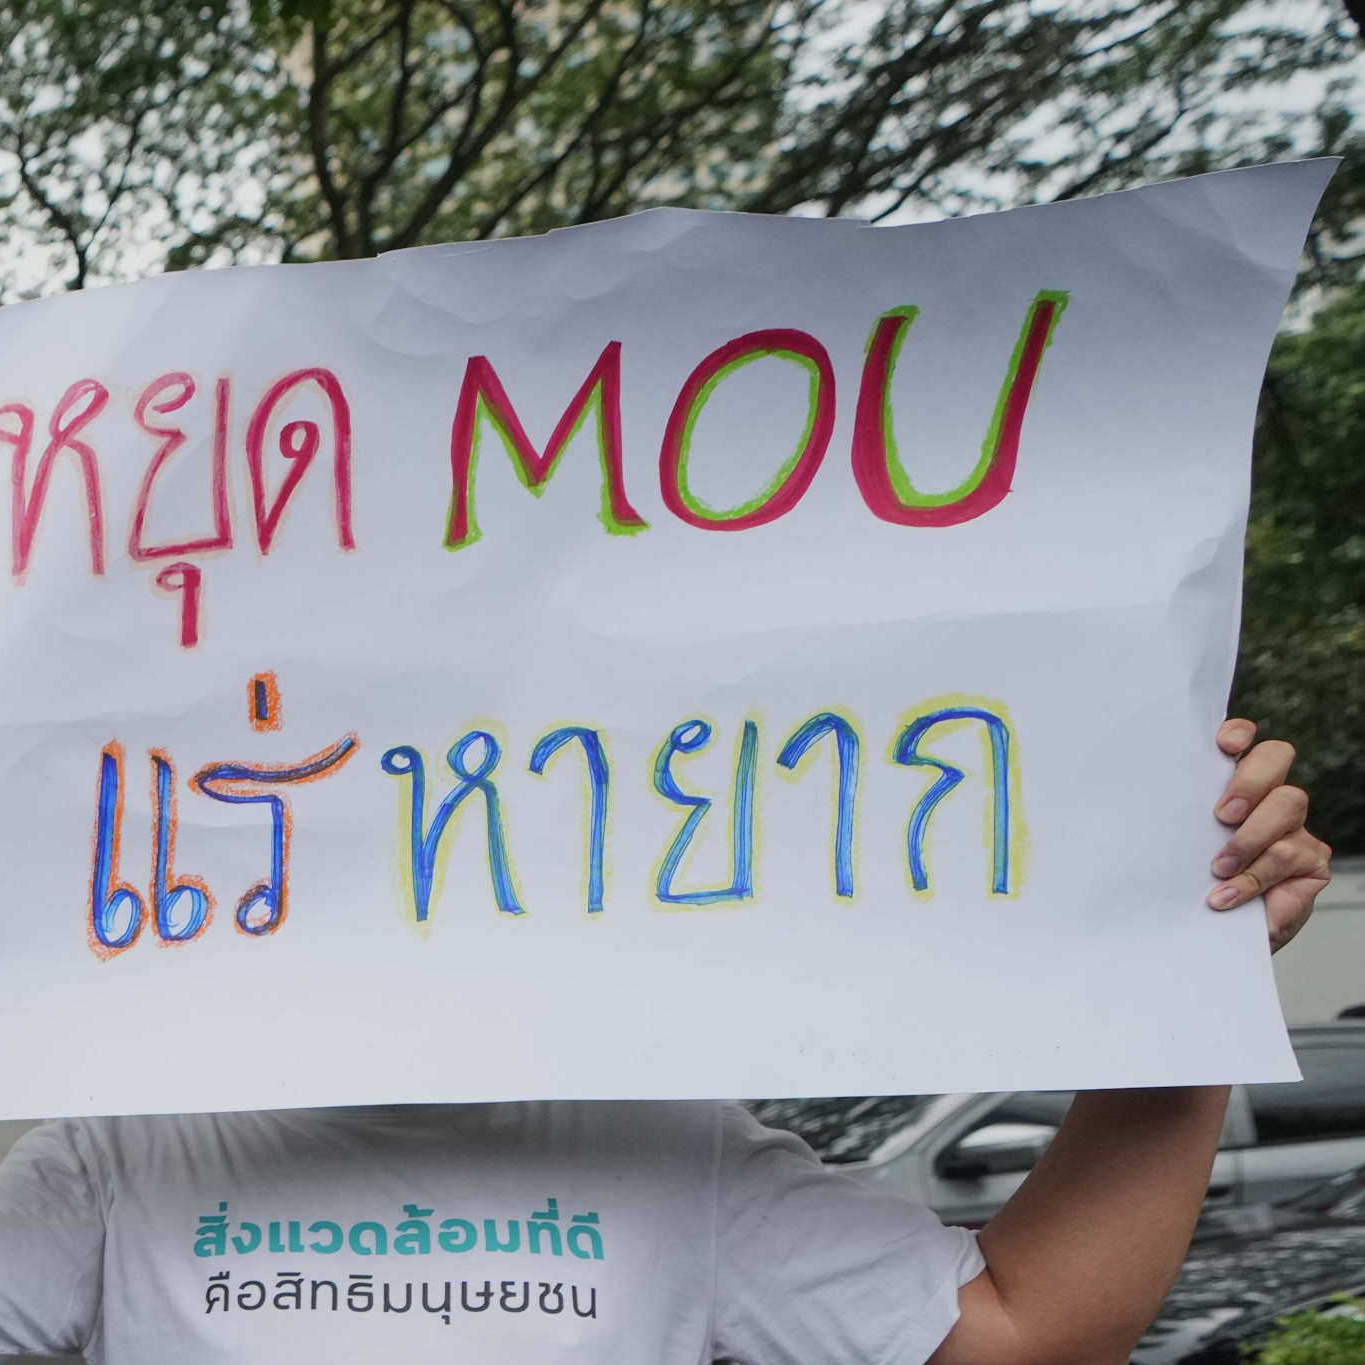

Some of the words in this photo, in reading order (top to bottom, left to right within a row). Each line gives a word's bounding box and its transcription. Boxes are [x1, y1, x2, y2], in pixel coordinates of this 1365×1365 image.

[441, 289, 1070, 553] MOU
[193, 1197, 605, 1260] สิ่งแวดล้อมที่ดี
[205, 1271, 597, 1325] คือสิทธิมนุษยชน
